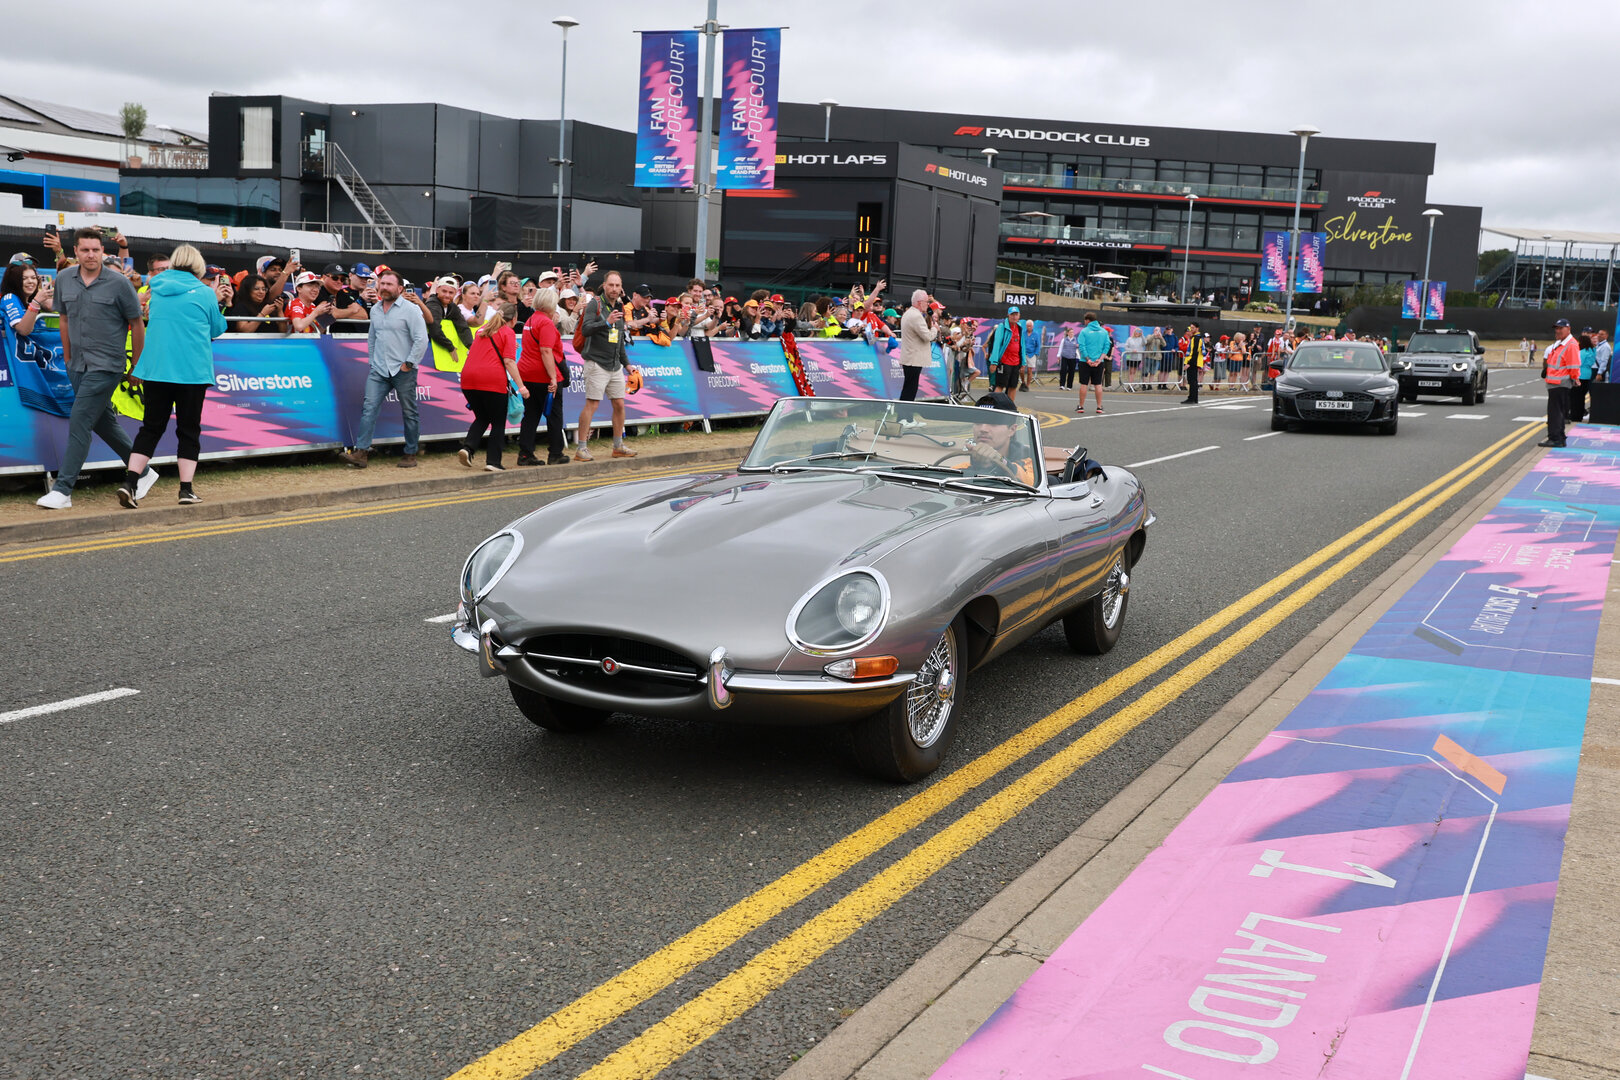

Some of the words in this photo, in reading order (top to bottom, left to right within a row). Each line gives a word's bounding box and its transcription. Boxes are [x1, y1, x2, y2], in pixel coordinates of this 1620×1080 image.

[666, 38, 685, 142] FORECOURT
[747, 36, 767, 143] FORECOURT
[651, 97, 666, 131] FAN
[732, 97, 747, 131] FAN
[985, 127, 1091, 144] PADDOCK
[1094, 134, 1150, 147] CLUB
[788, 154, 830, 165] HOT
[833, 154, 887, 165] LAPS
[949, 169, 966, 181] HOT
[966, 173, 988, 186] LAPS
[1347, 196, 1396, 204] PADDOCK
[1324, 211, 1414, 250] Silverstone
[1056, 239, 1104, 247] PADDOCK
[1006, 294, 1028, 306] BAR
[750, 362, 787, 374] Silverstone
[842, 360, 874, 370] Silverstone
[215, 373, 313, 392] Silverstone
[707, 375, 741, 388] FORECOURT
[1318, 401, 1336, 409] KS75
[1163, 911, 1343, 1065] LANDO
